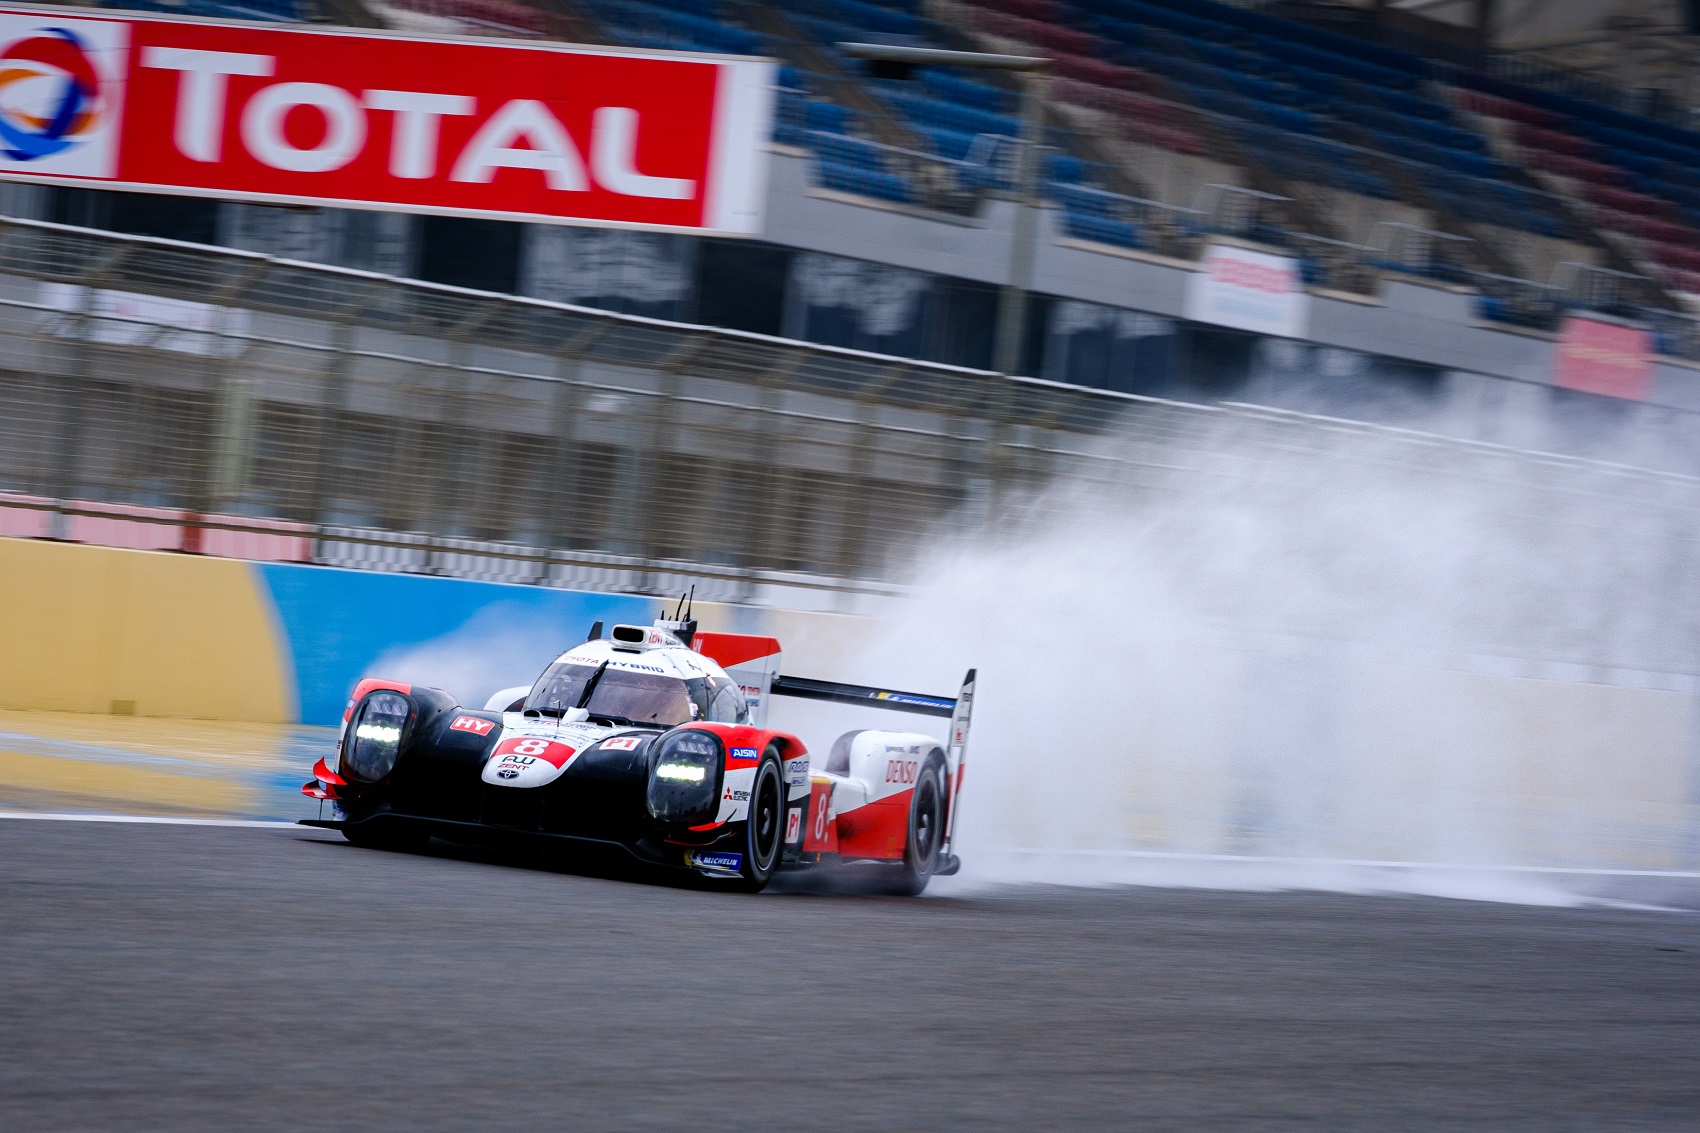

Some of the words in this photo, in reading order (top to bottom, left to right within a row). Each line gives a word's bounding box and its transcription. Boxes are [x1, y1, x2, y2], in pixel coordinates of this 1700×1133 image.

[141, 46, 697, 199] TOTAL
[562, 655, 599, 665] OYOTA
[607, 660, 665, 673] HYBRID
[454, 717, 491, 731] HY
[513, 739, 550, 755] 8
[606, 738, 635, 748] P1
[733, 748, 757, 758] AISIN
[497, 763, 530, 771] ZENT
[886, 760, 918, 784] DENSO
[815, 793, 827, 840] 8
[788, 813, 800, 838] P1
[703, 856, 738, 866] MICHELIN
